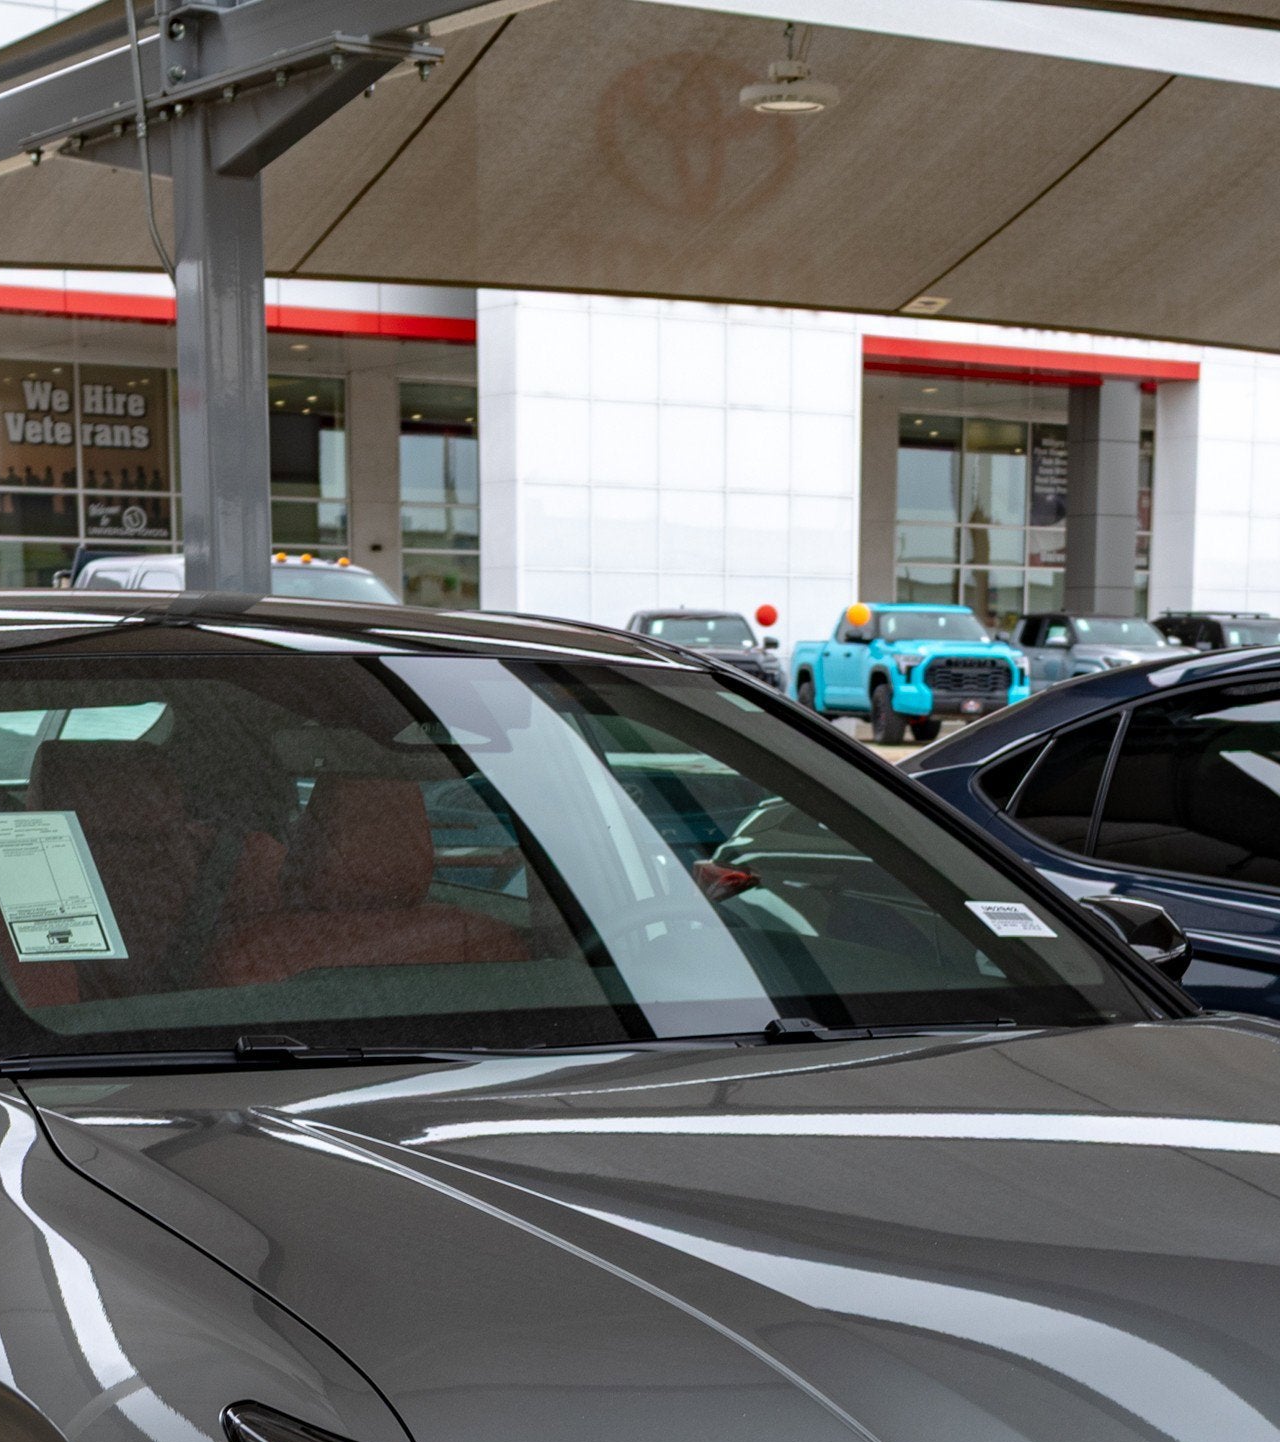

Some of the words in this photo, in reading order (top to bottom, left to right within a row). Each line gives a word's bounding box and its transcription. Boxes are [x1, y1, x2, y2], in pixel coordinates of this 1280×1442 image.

[22, 380, 70, 412] We
[83, 384, 146, 417] Hire
[4, 411, 150, 448] Veterans
